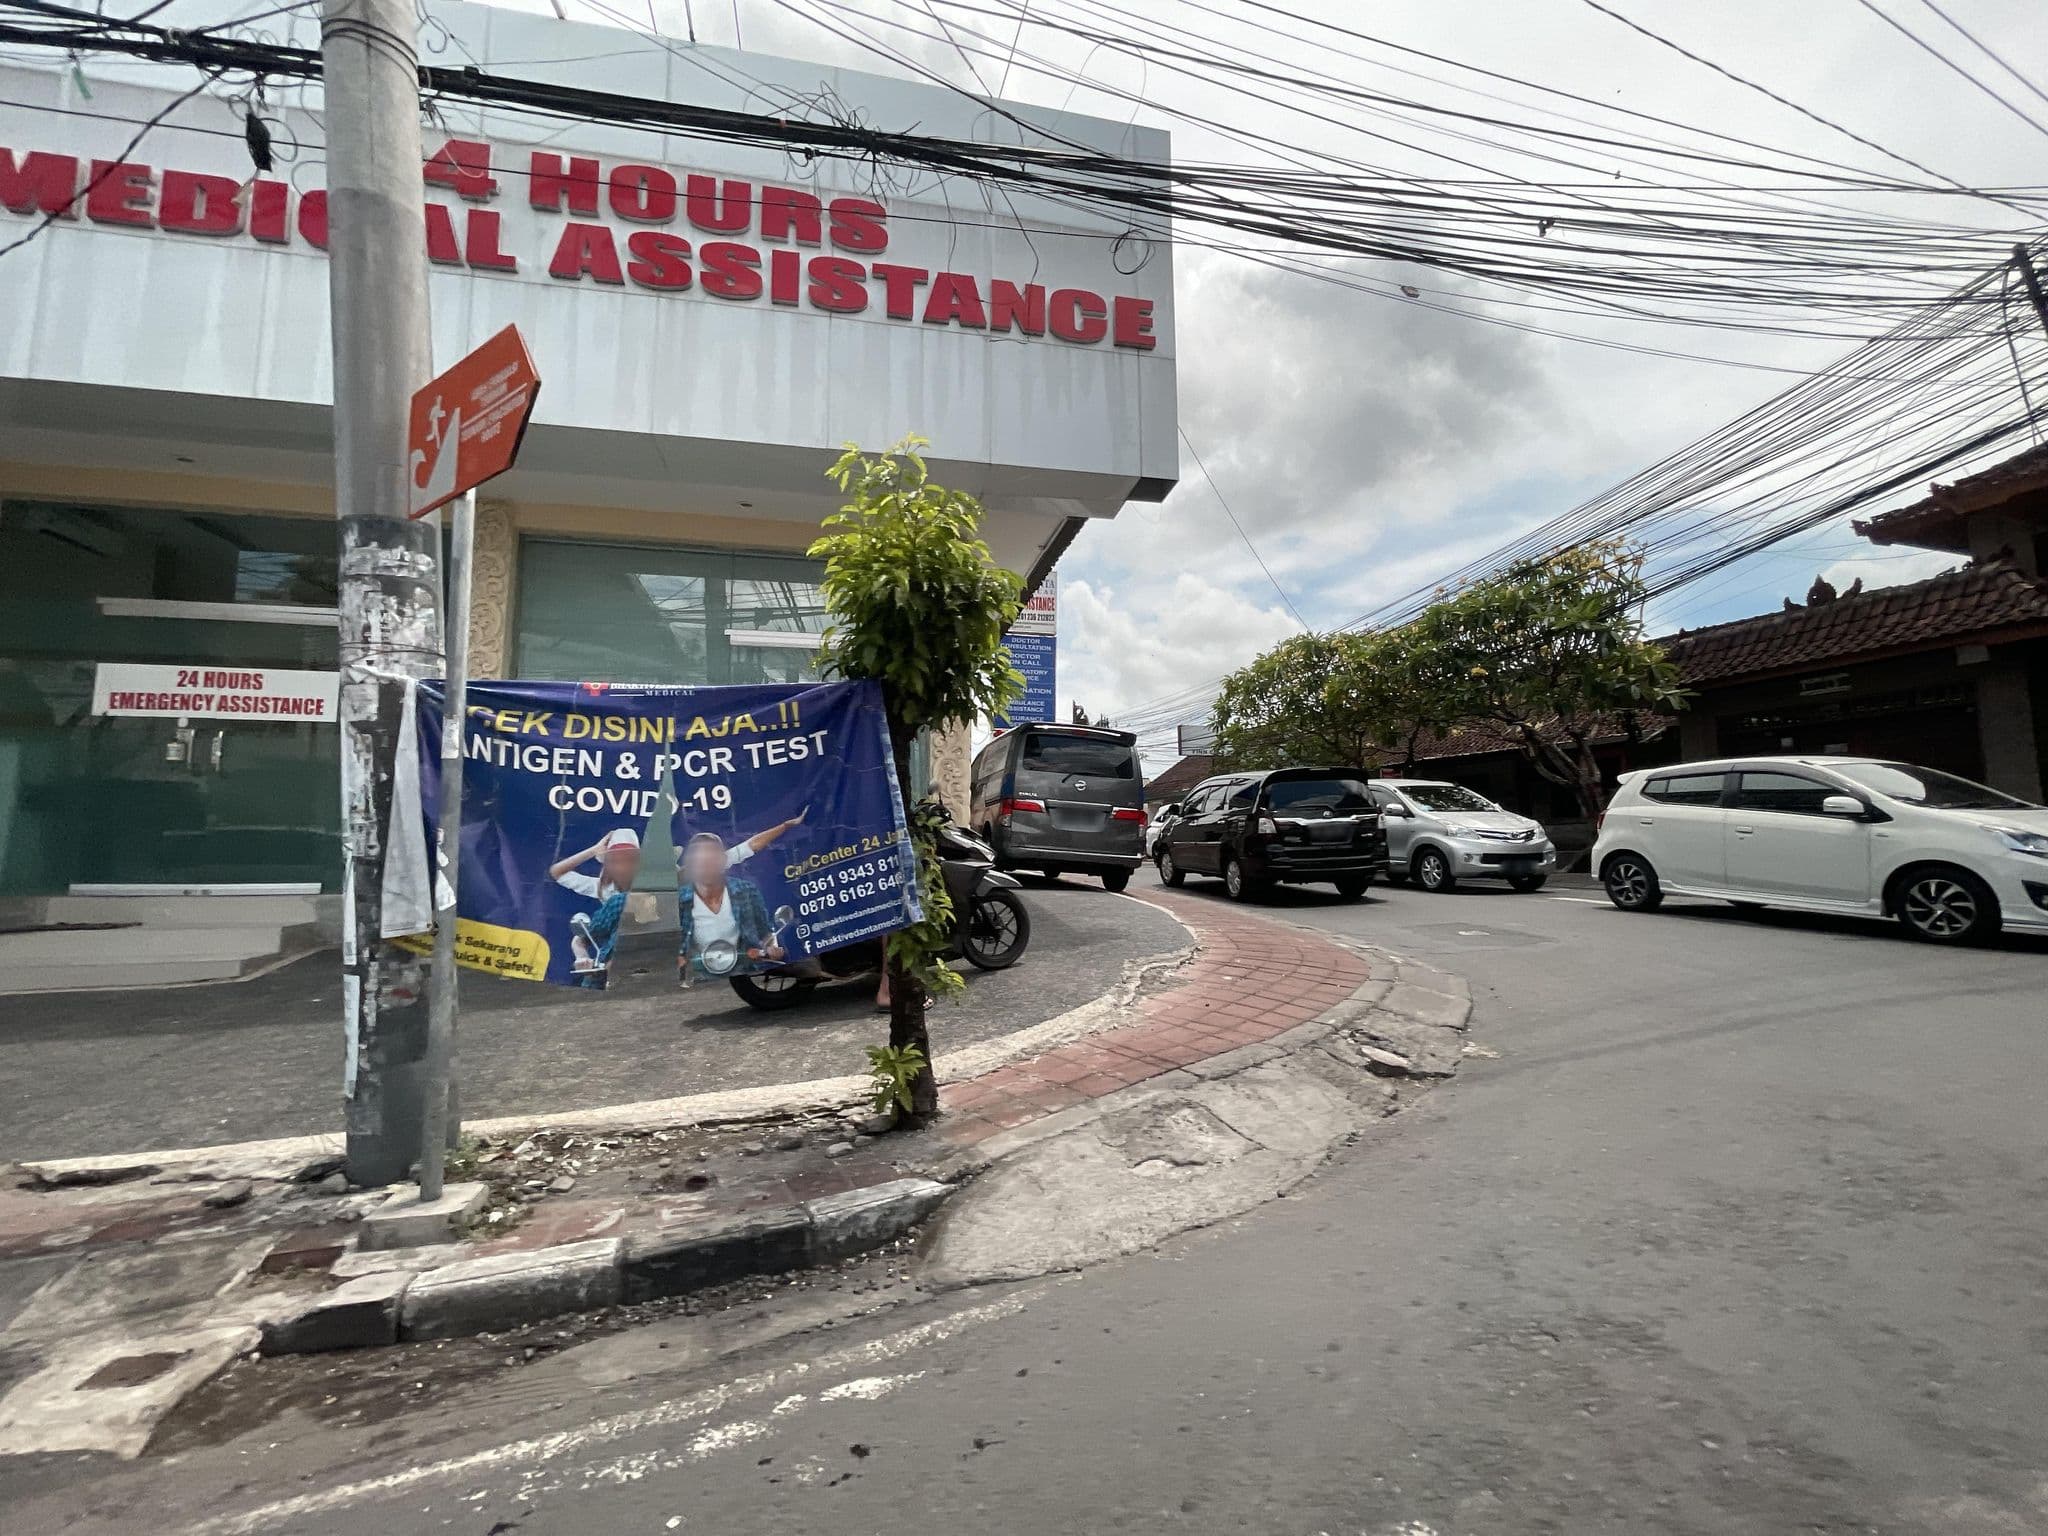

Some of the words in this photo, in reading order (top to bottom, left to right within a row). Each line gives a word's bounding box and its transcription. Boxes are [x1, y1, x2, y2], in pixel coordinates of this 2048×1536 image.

[423, 139, 498, 201] 4
[530, 151, 889, 255] HOURS
[548, 222, 1157, 351] ASSISTANCE
[1000, 643, 1051, 651] CONSULTATION
[177, 670, 199, 688] 24
[203, 671, 263, 690] HOURS
[1020, 687, 1052, 695] NATION
[109, 692, 215, 711] EMERGENCY
[217, 694, 324, 716] ASSISTANCE
[564, 711, 675, 744] DISINI
[614, 752, 641, 781] &
[653, 747, 735, 781] PCR
[743, 730, 829, 769] TEST
[547, 783, 733, 818] COVID-19
[809, 843, 858, 867] Center
[861, 835, 881, 852] 24
[800, 874, 835, 897] 0361
[838, 862, 875, 884] 9343
[800, 893, 836, 916] 0878
[839, 881, 876, 903] 6162
[454, 950, 480, 964] uick
[483, 956, 493, 966] &
[464, 936, 521, 957] Sekarang
